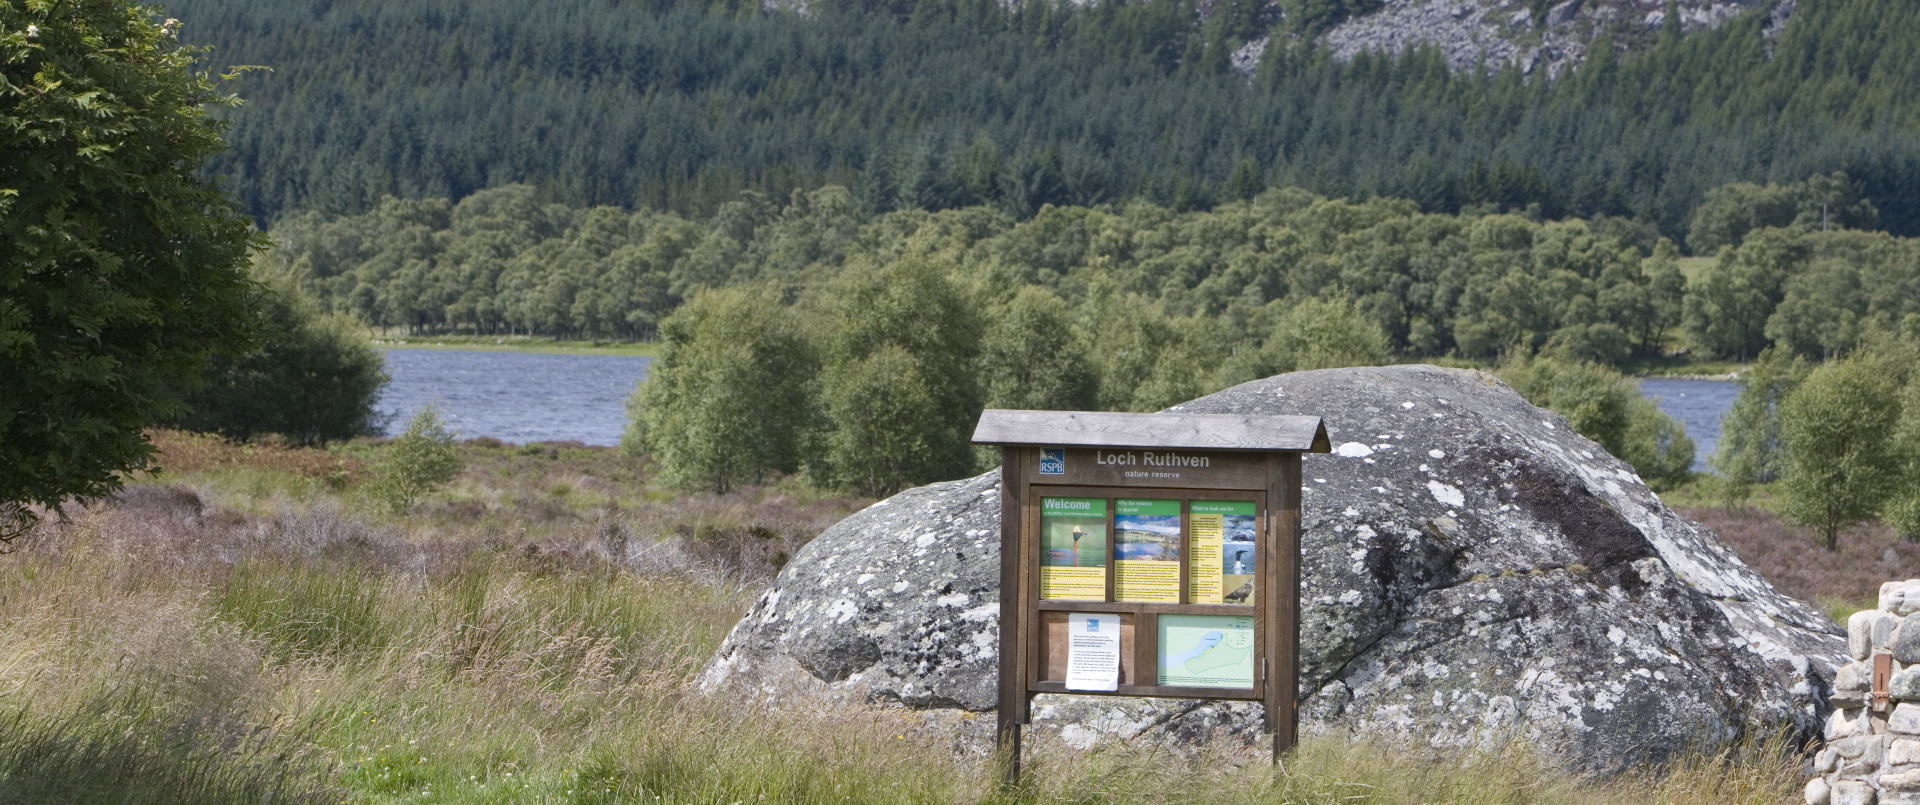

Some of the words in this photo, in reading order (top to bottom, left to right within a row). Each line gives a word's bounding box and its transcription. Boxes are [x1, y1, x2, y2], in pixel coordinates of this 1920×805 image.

[1097, 451, 1136, 465] Loch
[1143, 451, 1210, 467] Ruthven
[1041, 462, 1063, 473] RSPB
[1044, 498, 1090, 510] Welcome
